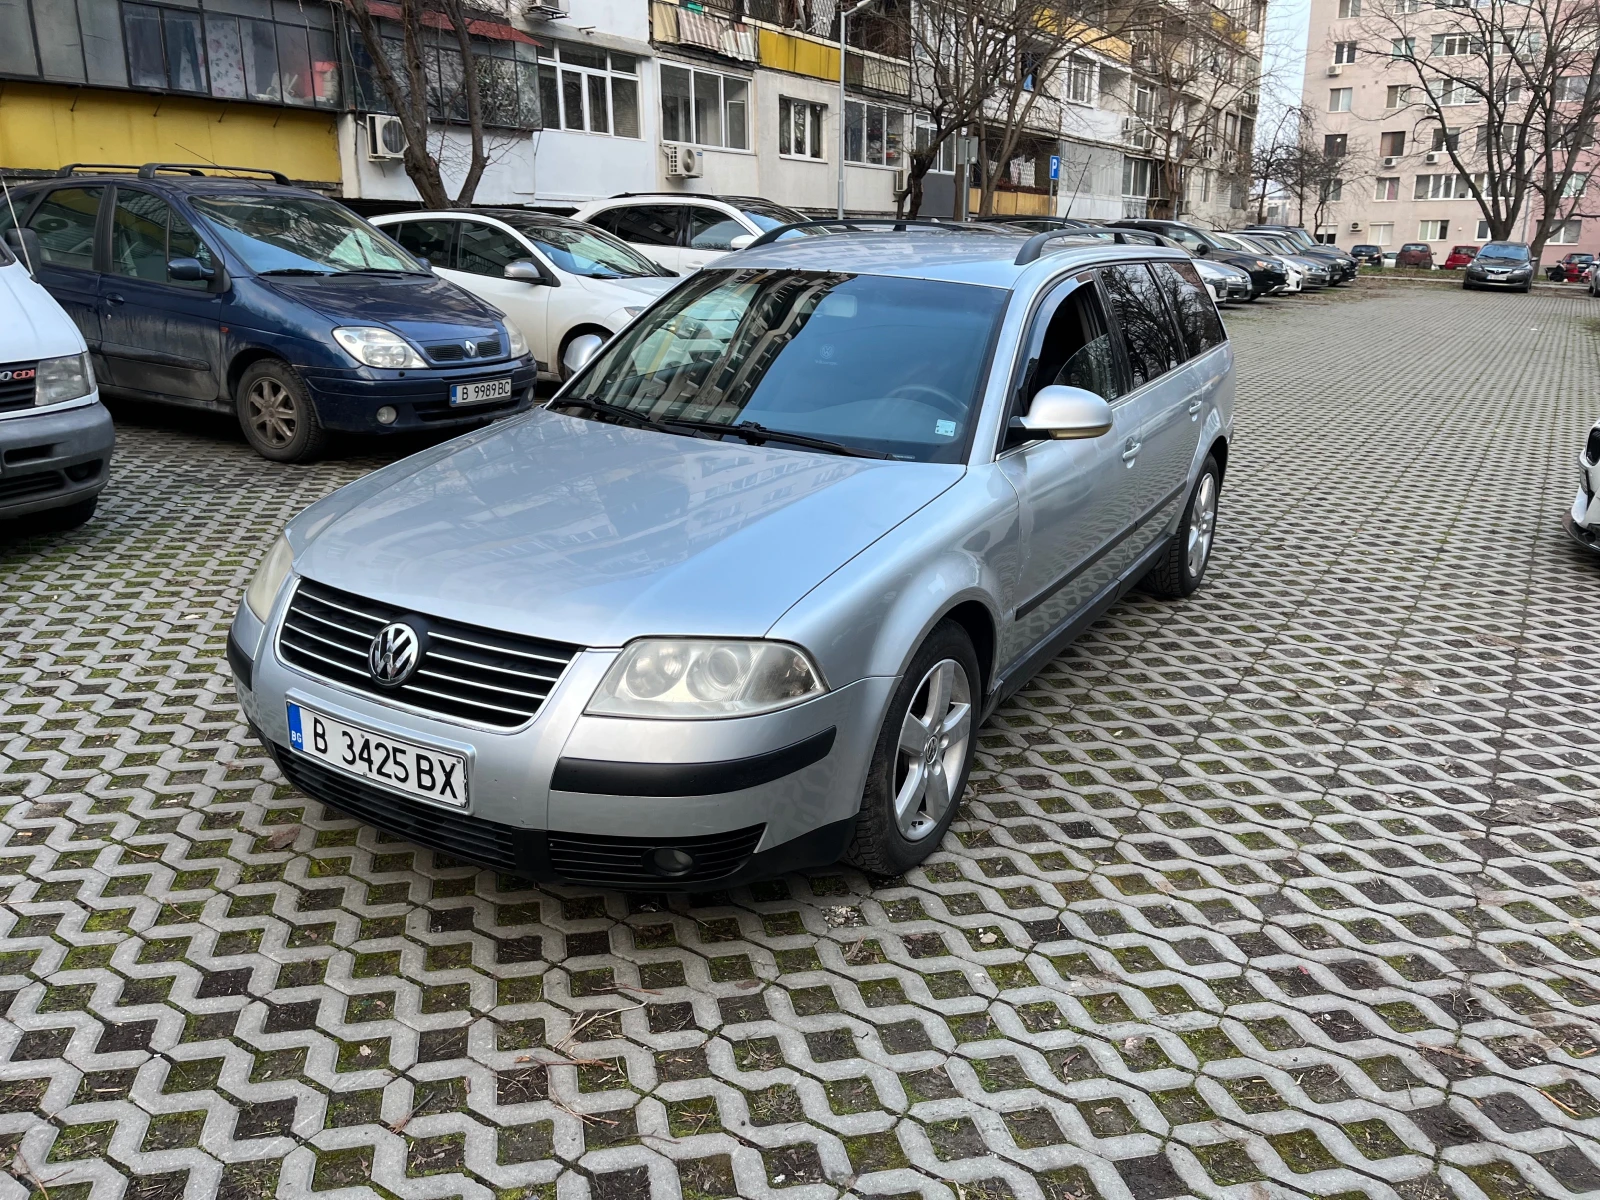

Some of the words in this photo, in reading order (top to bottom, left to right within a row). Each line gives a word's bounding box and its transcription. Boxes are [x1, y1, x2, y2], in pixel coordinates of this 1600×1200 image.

[1051, 158, 1058, 177] P
[12, 369, 35, 379] CDI
[462, 386, 468, 400] B
[474, 383, 496, 398] 9989
[497, 381, 509, 395] BC
[368, 622, 419, 686] VW
[291, 730, 302, 742] BG
[313, 717, 328, 754] B
[341, 730, 409, 783] 3425
[415, 753, 458, 799] BX
